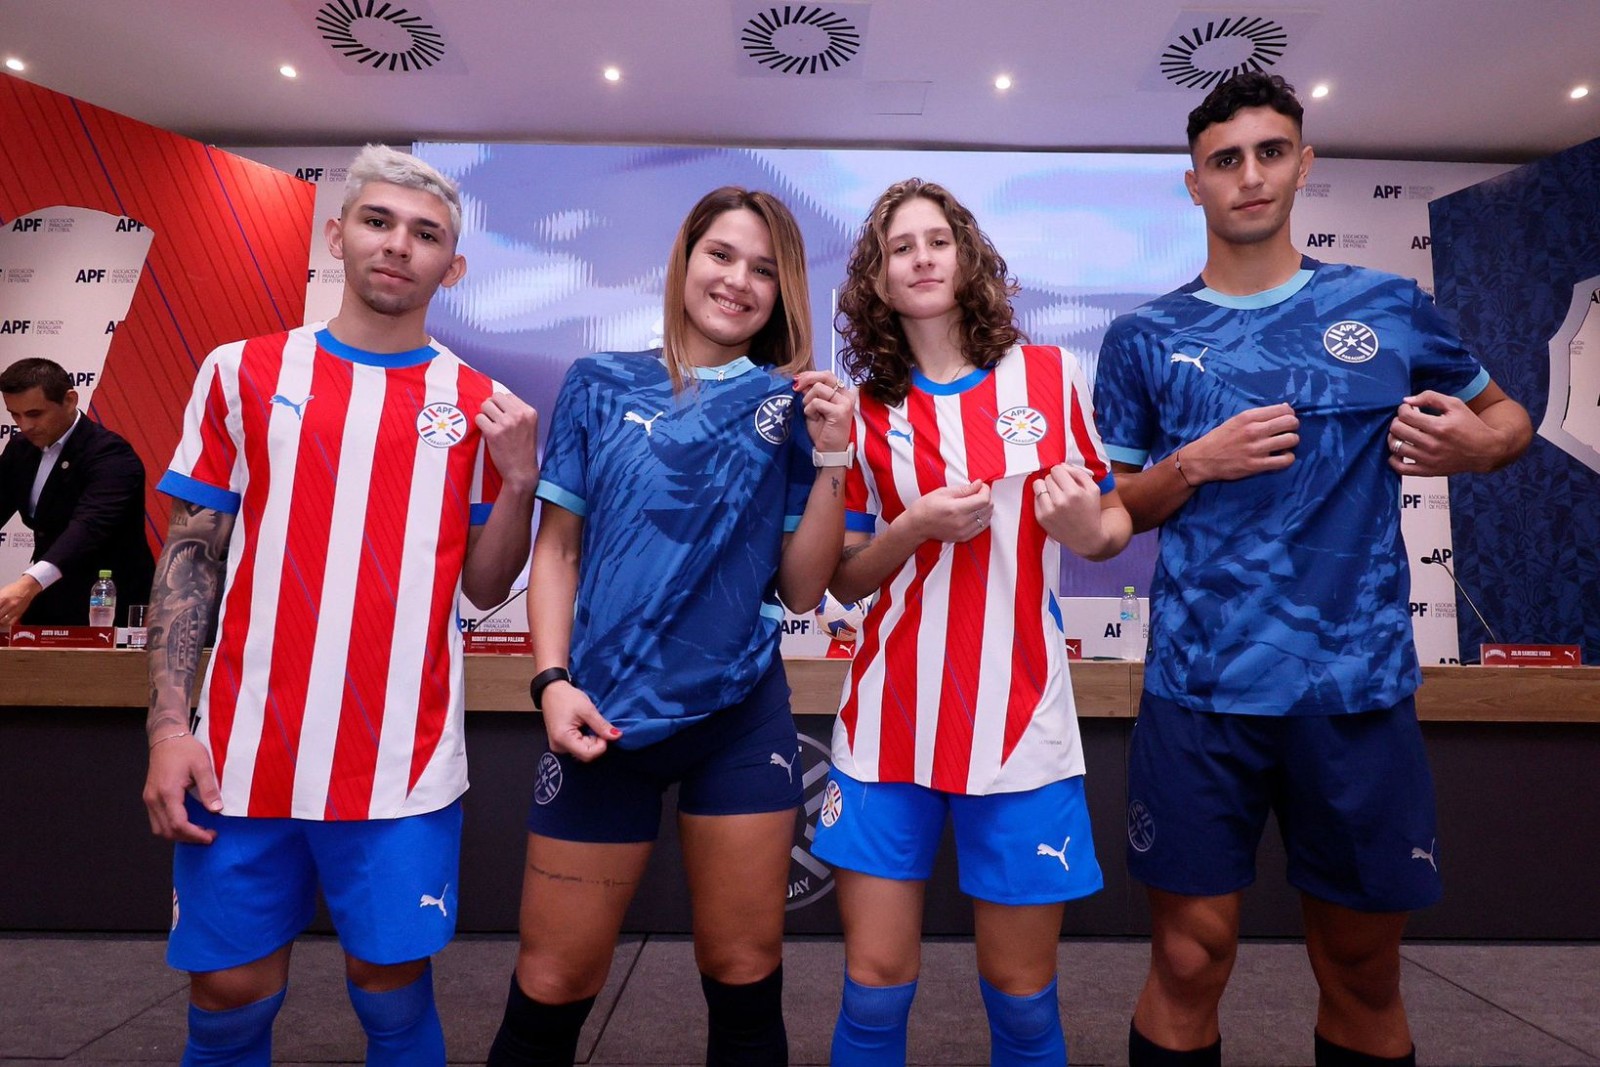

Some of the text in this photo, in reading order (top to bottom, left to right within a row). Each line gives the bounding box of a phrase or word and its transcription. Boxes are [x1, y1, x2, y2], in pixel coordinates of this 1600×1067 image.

[295, 168, 323, 181] APF
[1373, 185, 1402, 198] APF
[12, 218, 42, 232] APF
[115, 218, 144, 232] APF
[1307, 233, 1336, 247] APF
[1411, 236, 1431, 249] AP
[75, 269, 106, 283] APF
[1, 320, 31, 334] APF
[775, 399, 792, 407] APF
[436, 406, 453, 414] APF
[1, 425, 20, 438] PF
[1401, 495, 1421, 508] PF
[1432, 549, 1452, 562] AP
[1410, 603, 1427, 616] PF
[460, 618, 477, 632] PF
[781, 620, 810, 634] APF
